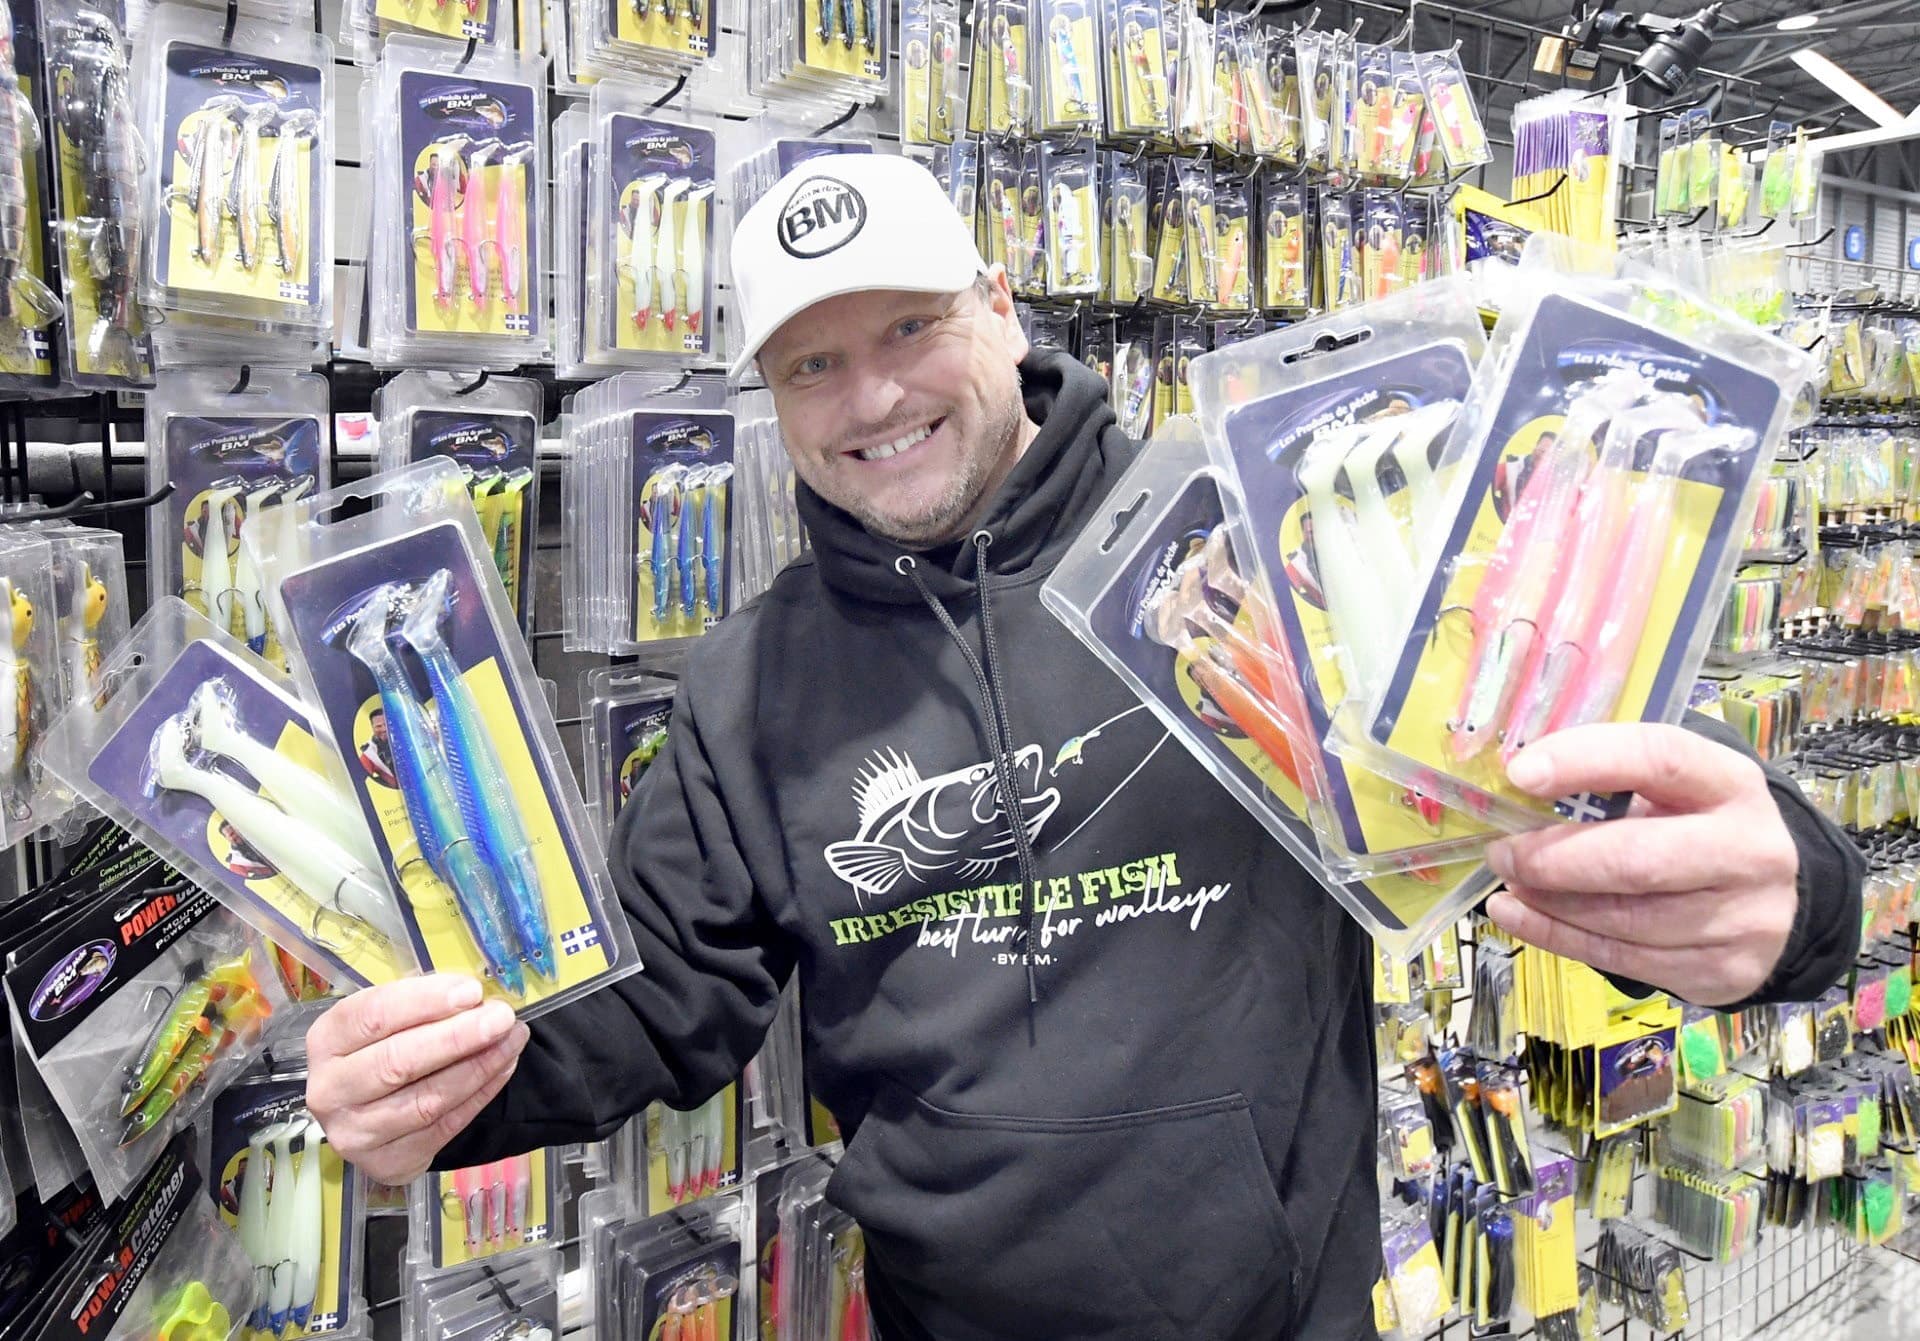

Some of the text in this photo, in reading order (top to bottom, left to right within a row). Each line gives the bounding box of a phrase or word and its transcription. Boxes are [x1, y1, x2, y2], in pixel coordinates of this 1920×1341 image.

[786, 192, 857, 243] BM
[455, 436, 478, 444] BM
[1279, 390, 1379, 448] Les Produits de pêche
[221, 440, 250, 451] BM
[1134, 609, 1145, 624] Les
[1140, 577, 1160, 608] Produits
[1157, 565, 1166, 577] de
[332, 621, 346, 634] Les
[1078, 852, 1182, 906] FISH
[121, 895, 176, 946] POWER
[156, 917, 191, 950] POWER
[917, 904, 972, 958] best
[1041, 898, 1082, 948] for
[1095, 864, 1232, 930] walleye
[55, 968, 76, 996] BM
[997, 954, 1018, 965] BY
[130, 1161, 184, 1252] Catcher
